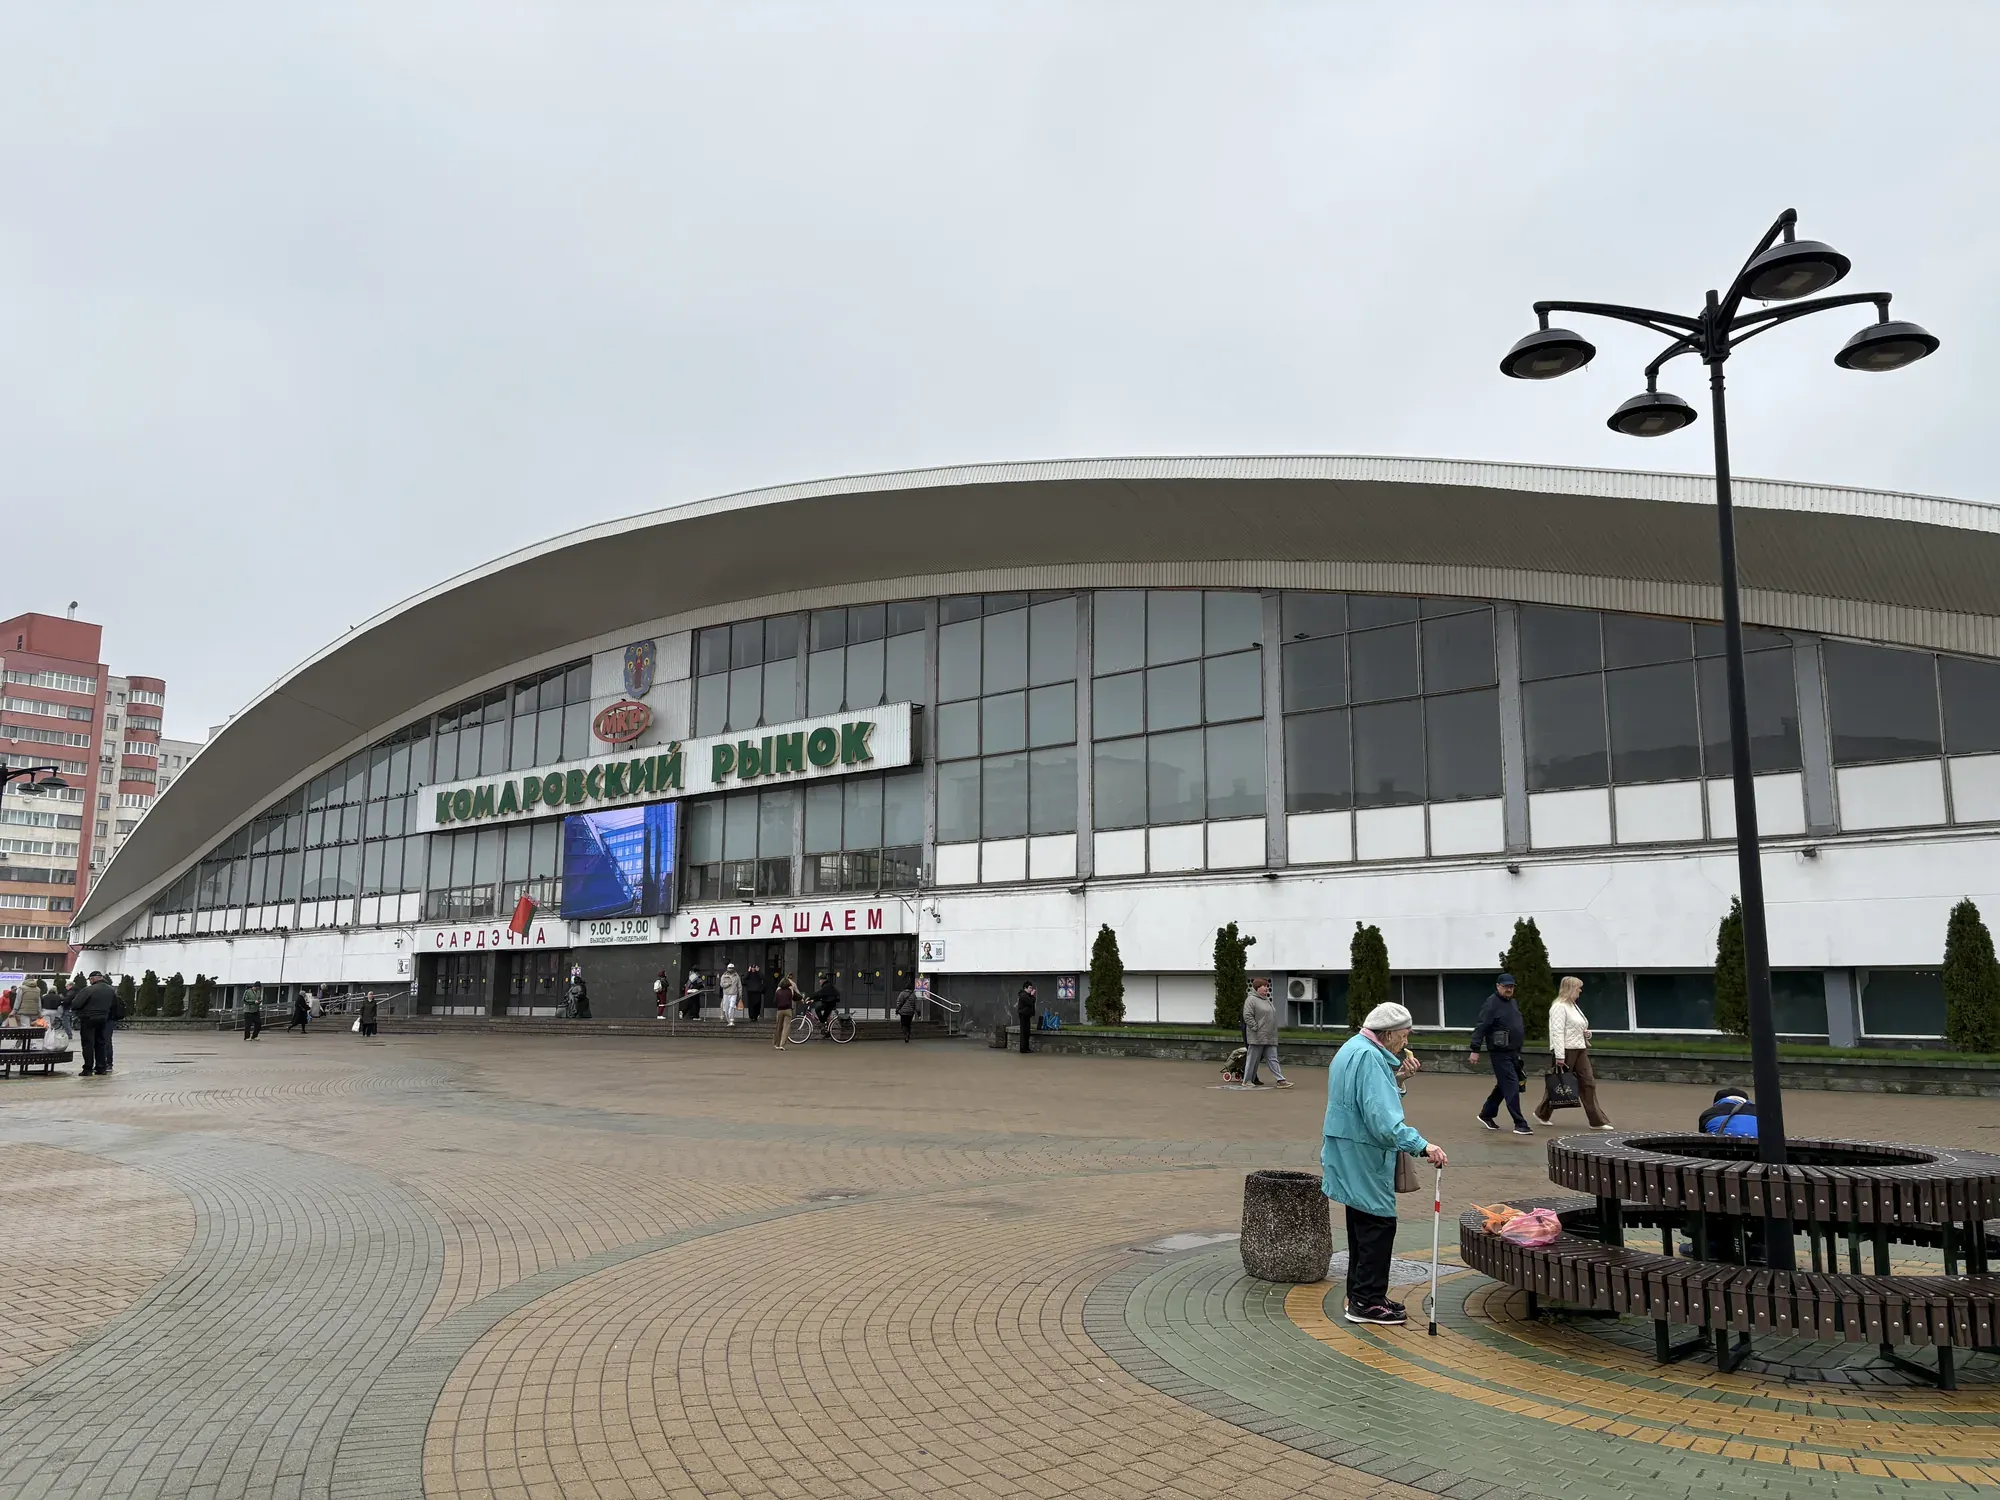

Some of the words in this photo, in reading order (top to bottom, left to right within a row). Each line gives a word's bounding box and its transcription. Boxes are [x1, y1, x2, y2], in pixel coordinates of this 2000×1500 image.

[602, 708, 641, 734] МКР
[436, 741, 687, 824] КОМАРОВСКИЙ
[711, 721, 876, 783] РЫНОК
[590, 921, 611, 936] 9.00
[620, 919, 649, 934] 19.00
[690, 908, 882, 938] ЗАПРАШАЕМ
[436, 927, 546, 949] САРДЭЧНА
